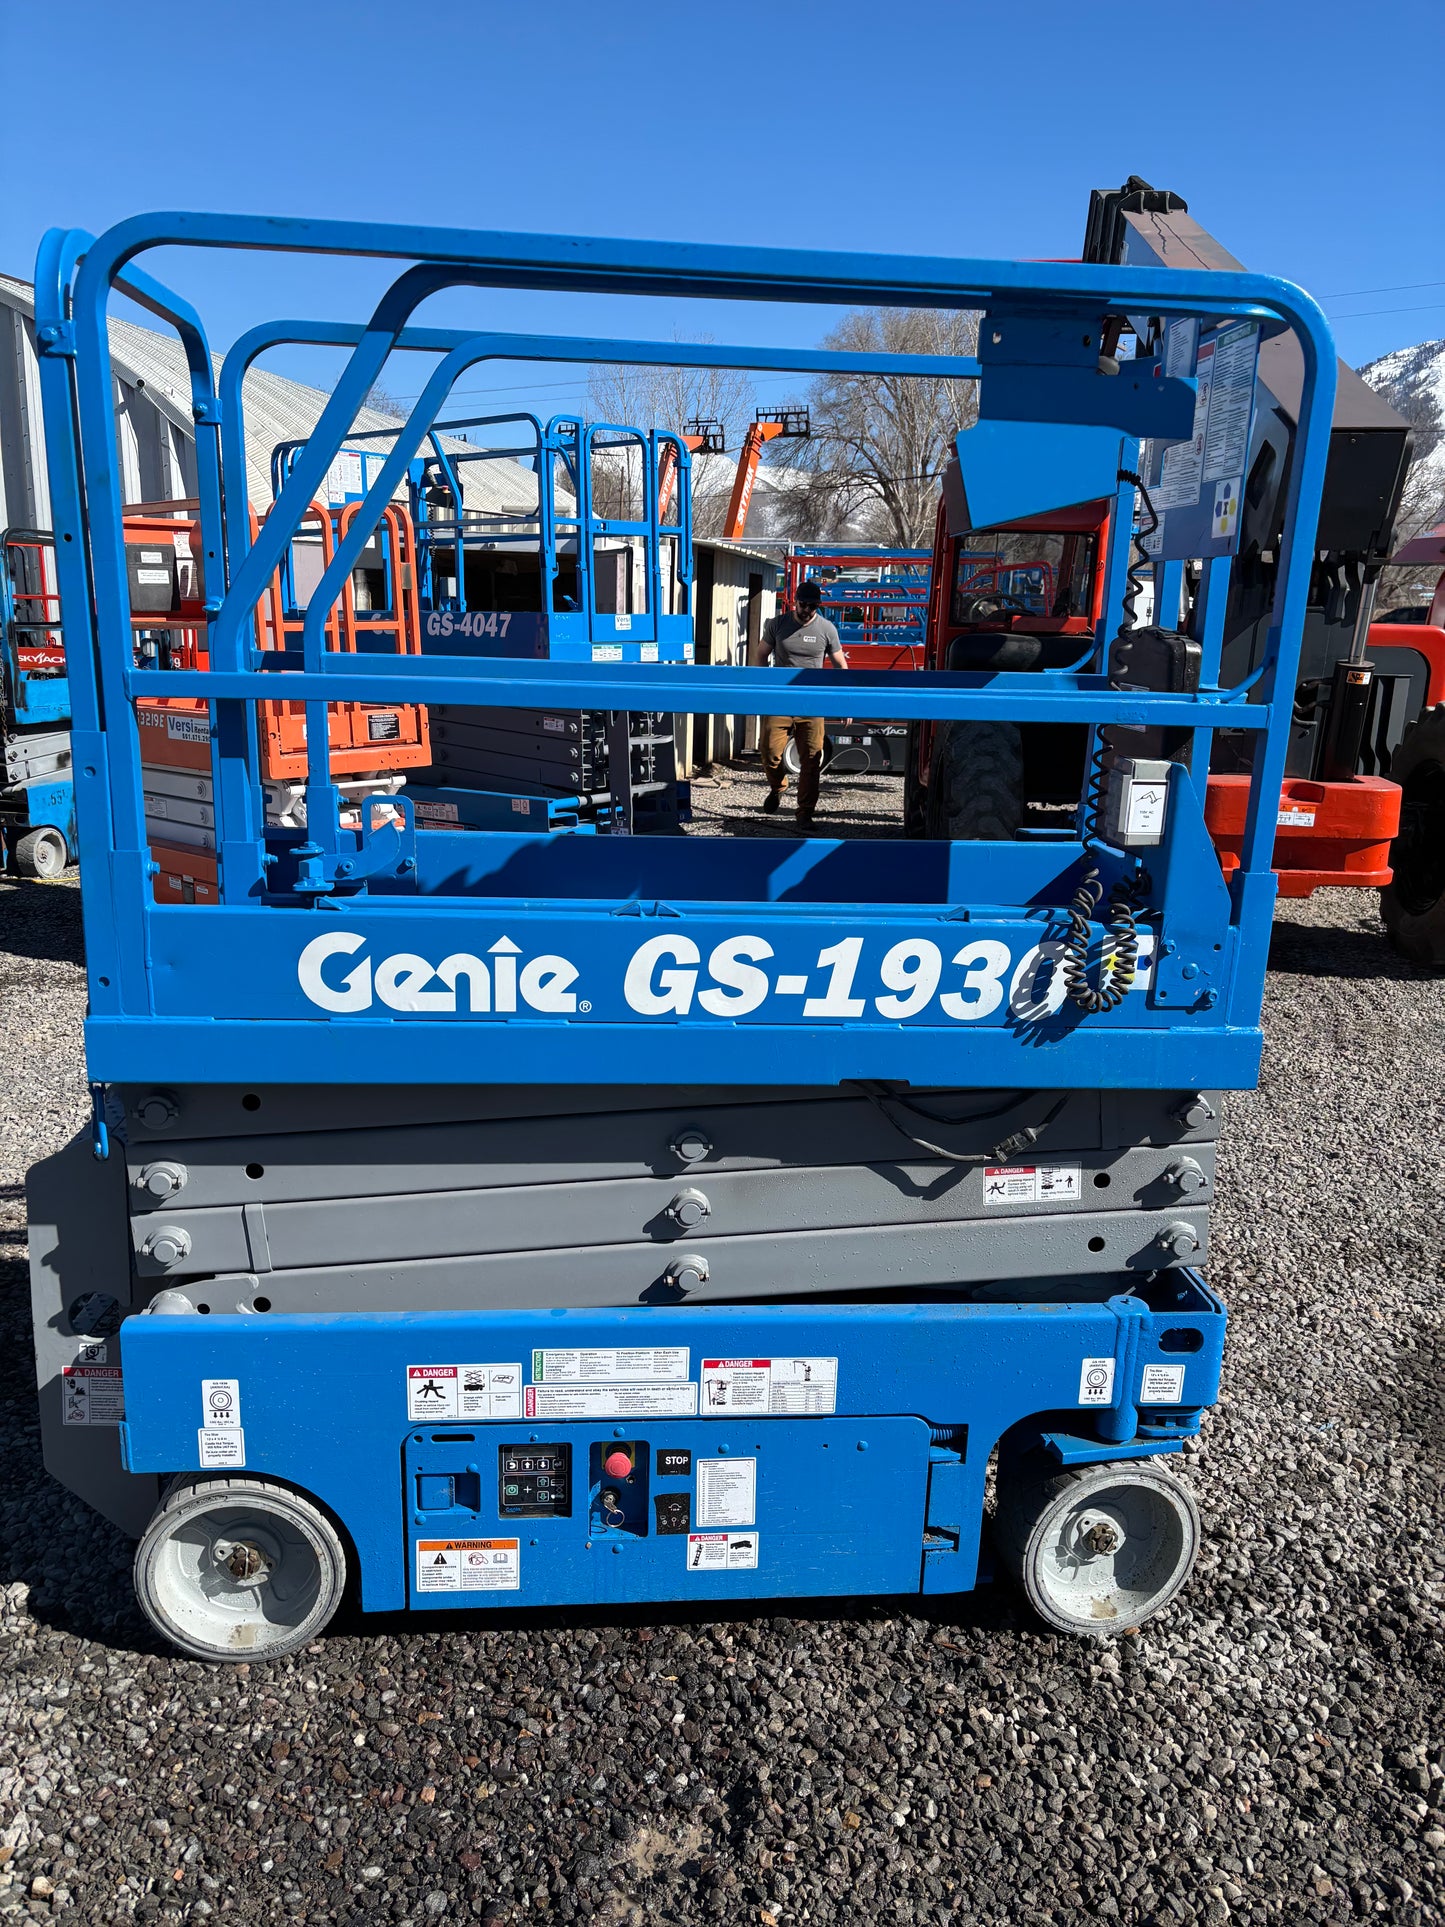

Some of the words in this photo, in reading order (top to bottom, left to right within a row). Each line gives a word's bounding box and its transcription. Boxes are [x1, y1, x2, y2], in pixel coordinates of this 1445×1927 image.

[737, 463, 755, 526] SKYTRAK
[427, 612, 512, 638] GS-4047
[137, 711, 165, 729] 3219E
[168, 716, 194, 734] Versi
[194, 725, 209, 735] Renta
[297, 931, 580, 1013] Genie
[623, 934, 1077, 1023] GS-1930
[84, 1368, 119, 1377] DANGER
[422, 1369, 454, 1377] DANGER
[724, 1360, 753, 1368] DANGER
[665, 1456, 689, 1465] STOP
[454, 1541, 492, 1549] WARNING
